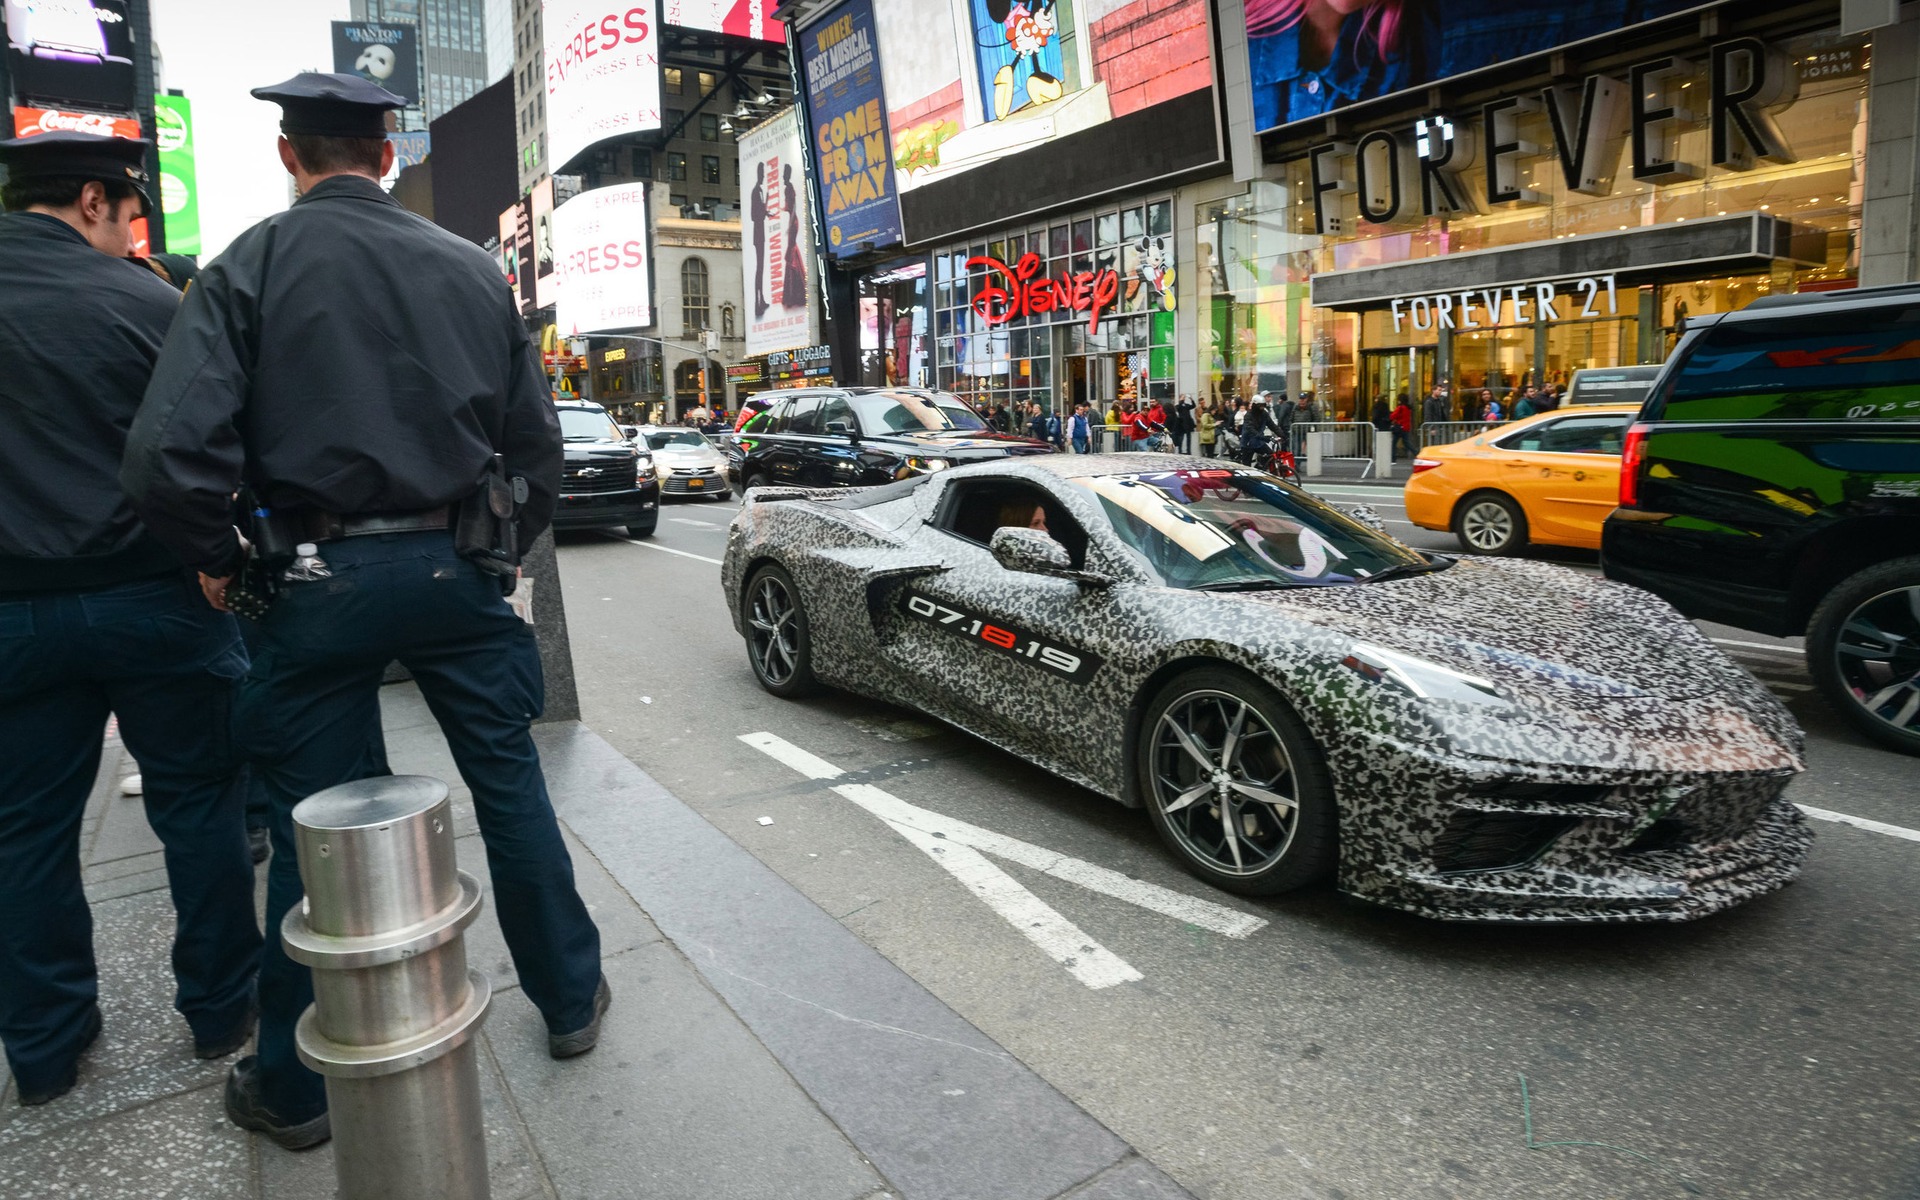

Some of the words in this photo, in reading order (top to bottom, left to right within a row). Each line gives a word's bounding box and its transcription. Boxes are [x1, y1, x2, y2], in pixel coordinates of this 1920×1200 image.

[344, 27, 403, 40] PHANTOM
[548, 7, 649, 95] EXPRESS
[808, 51, 829, 83] BEST
[829, 27, 872, 71] MUSICAL
[818, 97, 882, 153] COME
[1308, 36, 1770, 236] FOREVER
[821, 129, 887, 185] FROM
[827, 161, 888, 215] AWAY
[769, 232, 784, 304] WOMAN
[1391, 281, 1560, 334] FOREVER
[1577, 274, 1618, 318] 21
[768, 351, 790, 366] GIFTS
[793, 344, 831, 362] LUGGAGE
[907, 595, 1082, 674] 07.18.19
